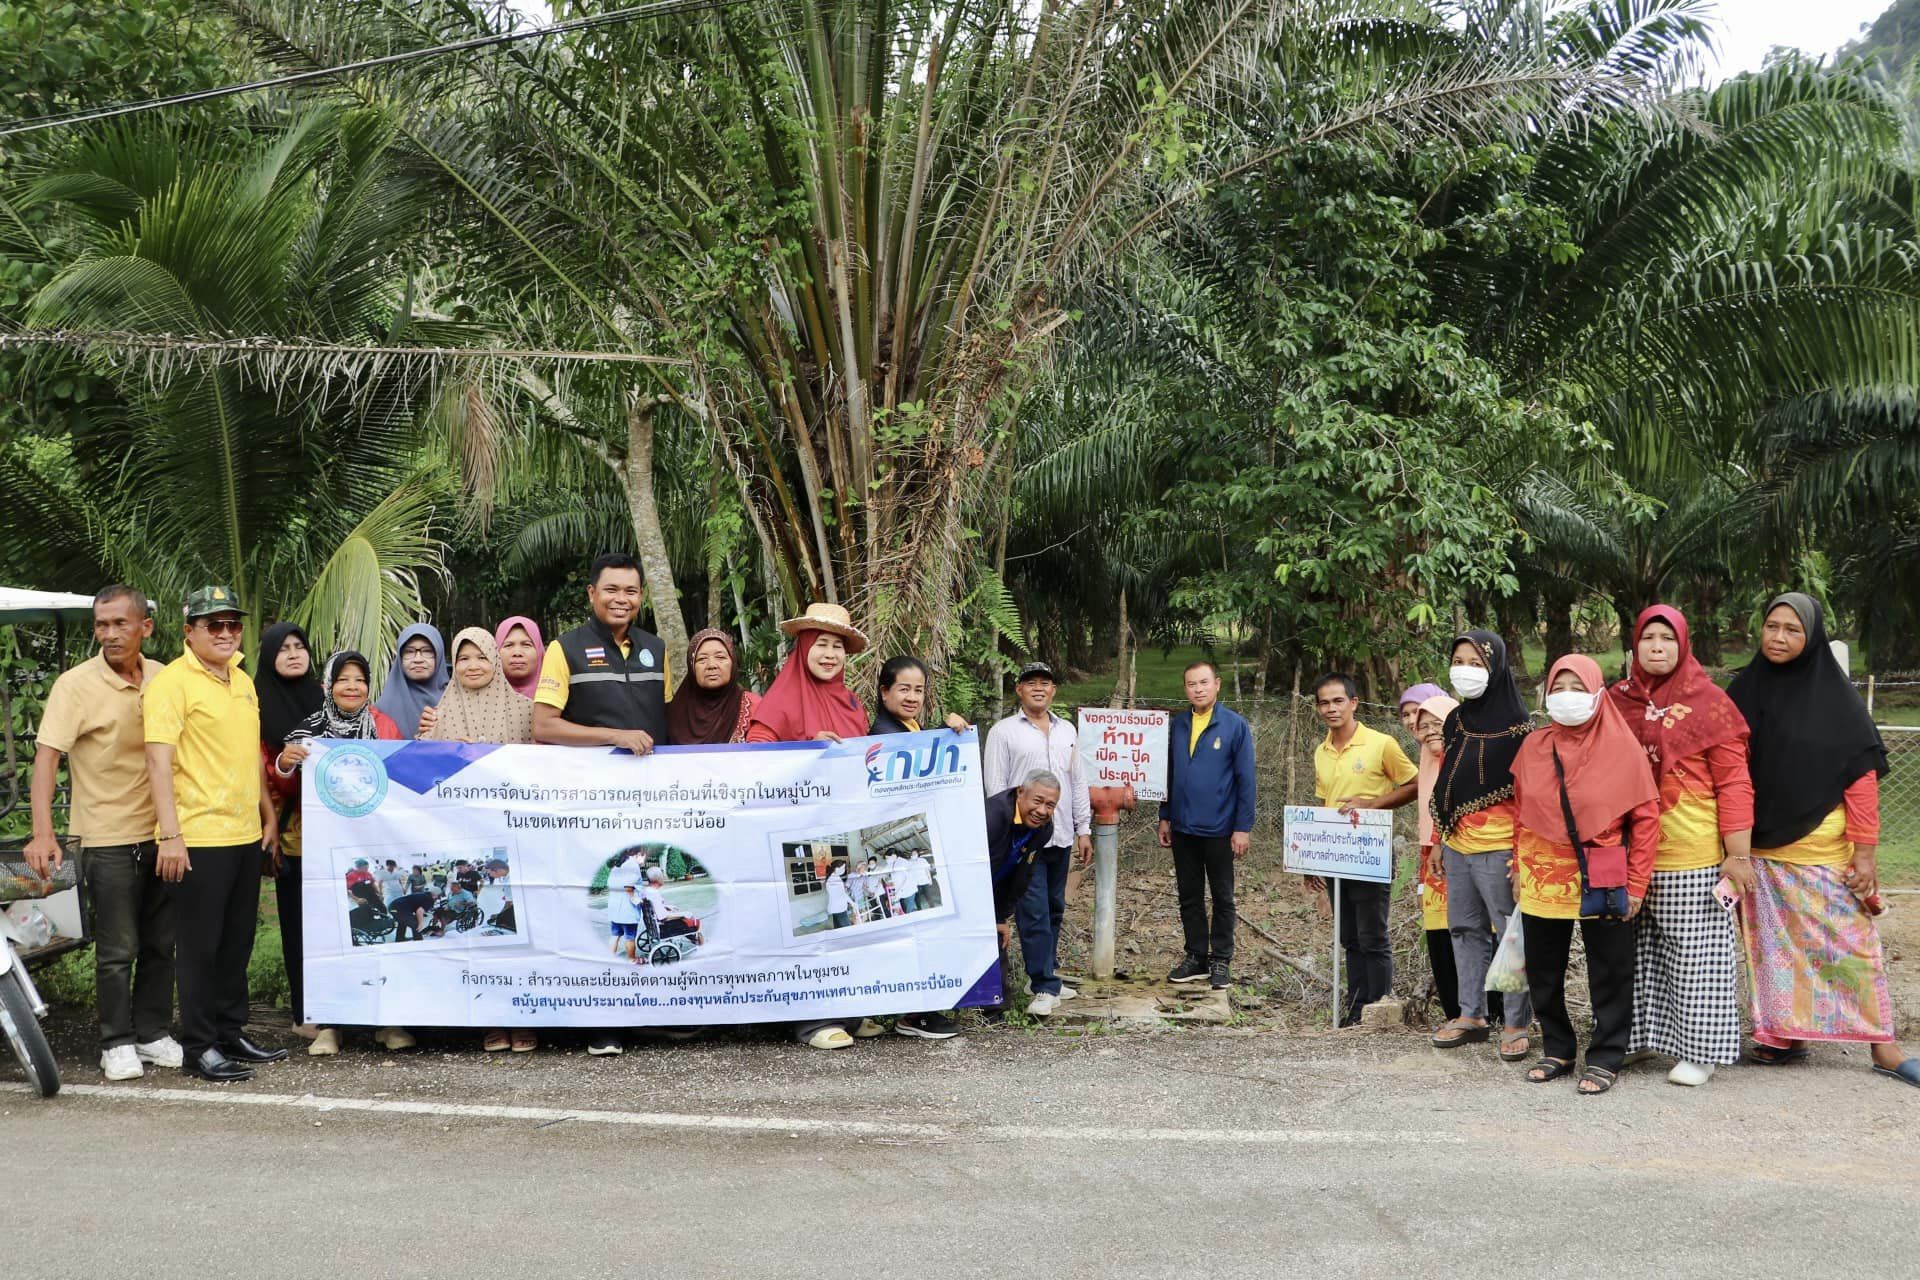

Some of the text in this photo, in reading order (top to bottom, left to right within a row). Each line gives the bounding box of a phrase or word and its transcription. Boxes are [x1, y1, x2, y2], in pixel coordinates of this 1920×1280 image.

[1085, 713, 1163, 725] ขอความร่วมมือ
[1104, 726, 1143, 745] ห้าม
[885, 737, 967, 781] กปท.
[1096, 748, 1118, 761] เปิด
[1131, 749, 1150, 763] ปิด
[1099, 763, 1146, 787] ประตูน้ำ
[435, 778, 831, 806] โครงการจัดบริการสาธารณสุขเคลื่อนที่เชิงรุกในหมู่บ้าน
[504, 809, 725, 829] ในเขตเทศบาลตำบลกระบี่น้อย
[1293, 829, 1385, 850] กองทุนหลักประกันสุขภาพ
[1299, 847, 1381, 866] เทศบาลตำบลกระบี่น้อย
[462, 970, 513, 986] กิจกรรม
[528, 964, 850, 991] สำรวจและเยี่ยมติดตามผู้พิการทุพพลภาพในชุมชน
